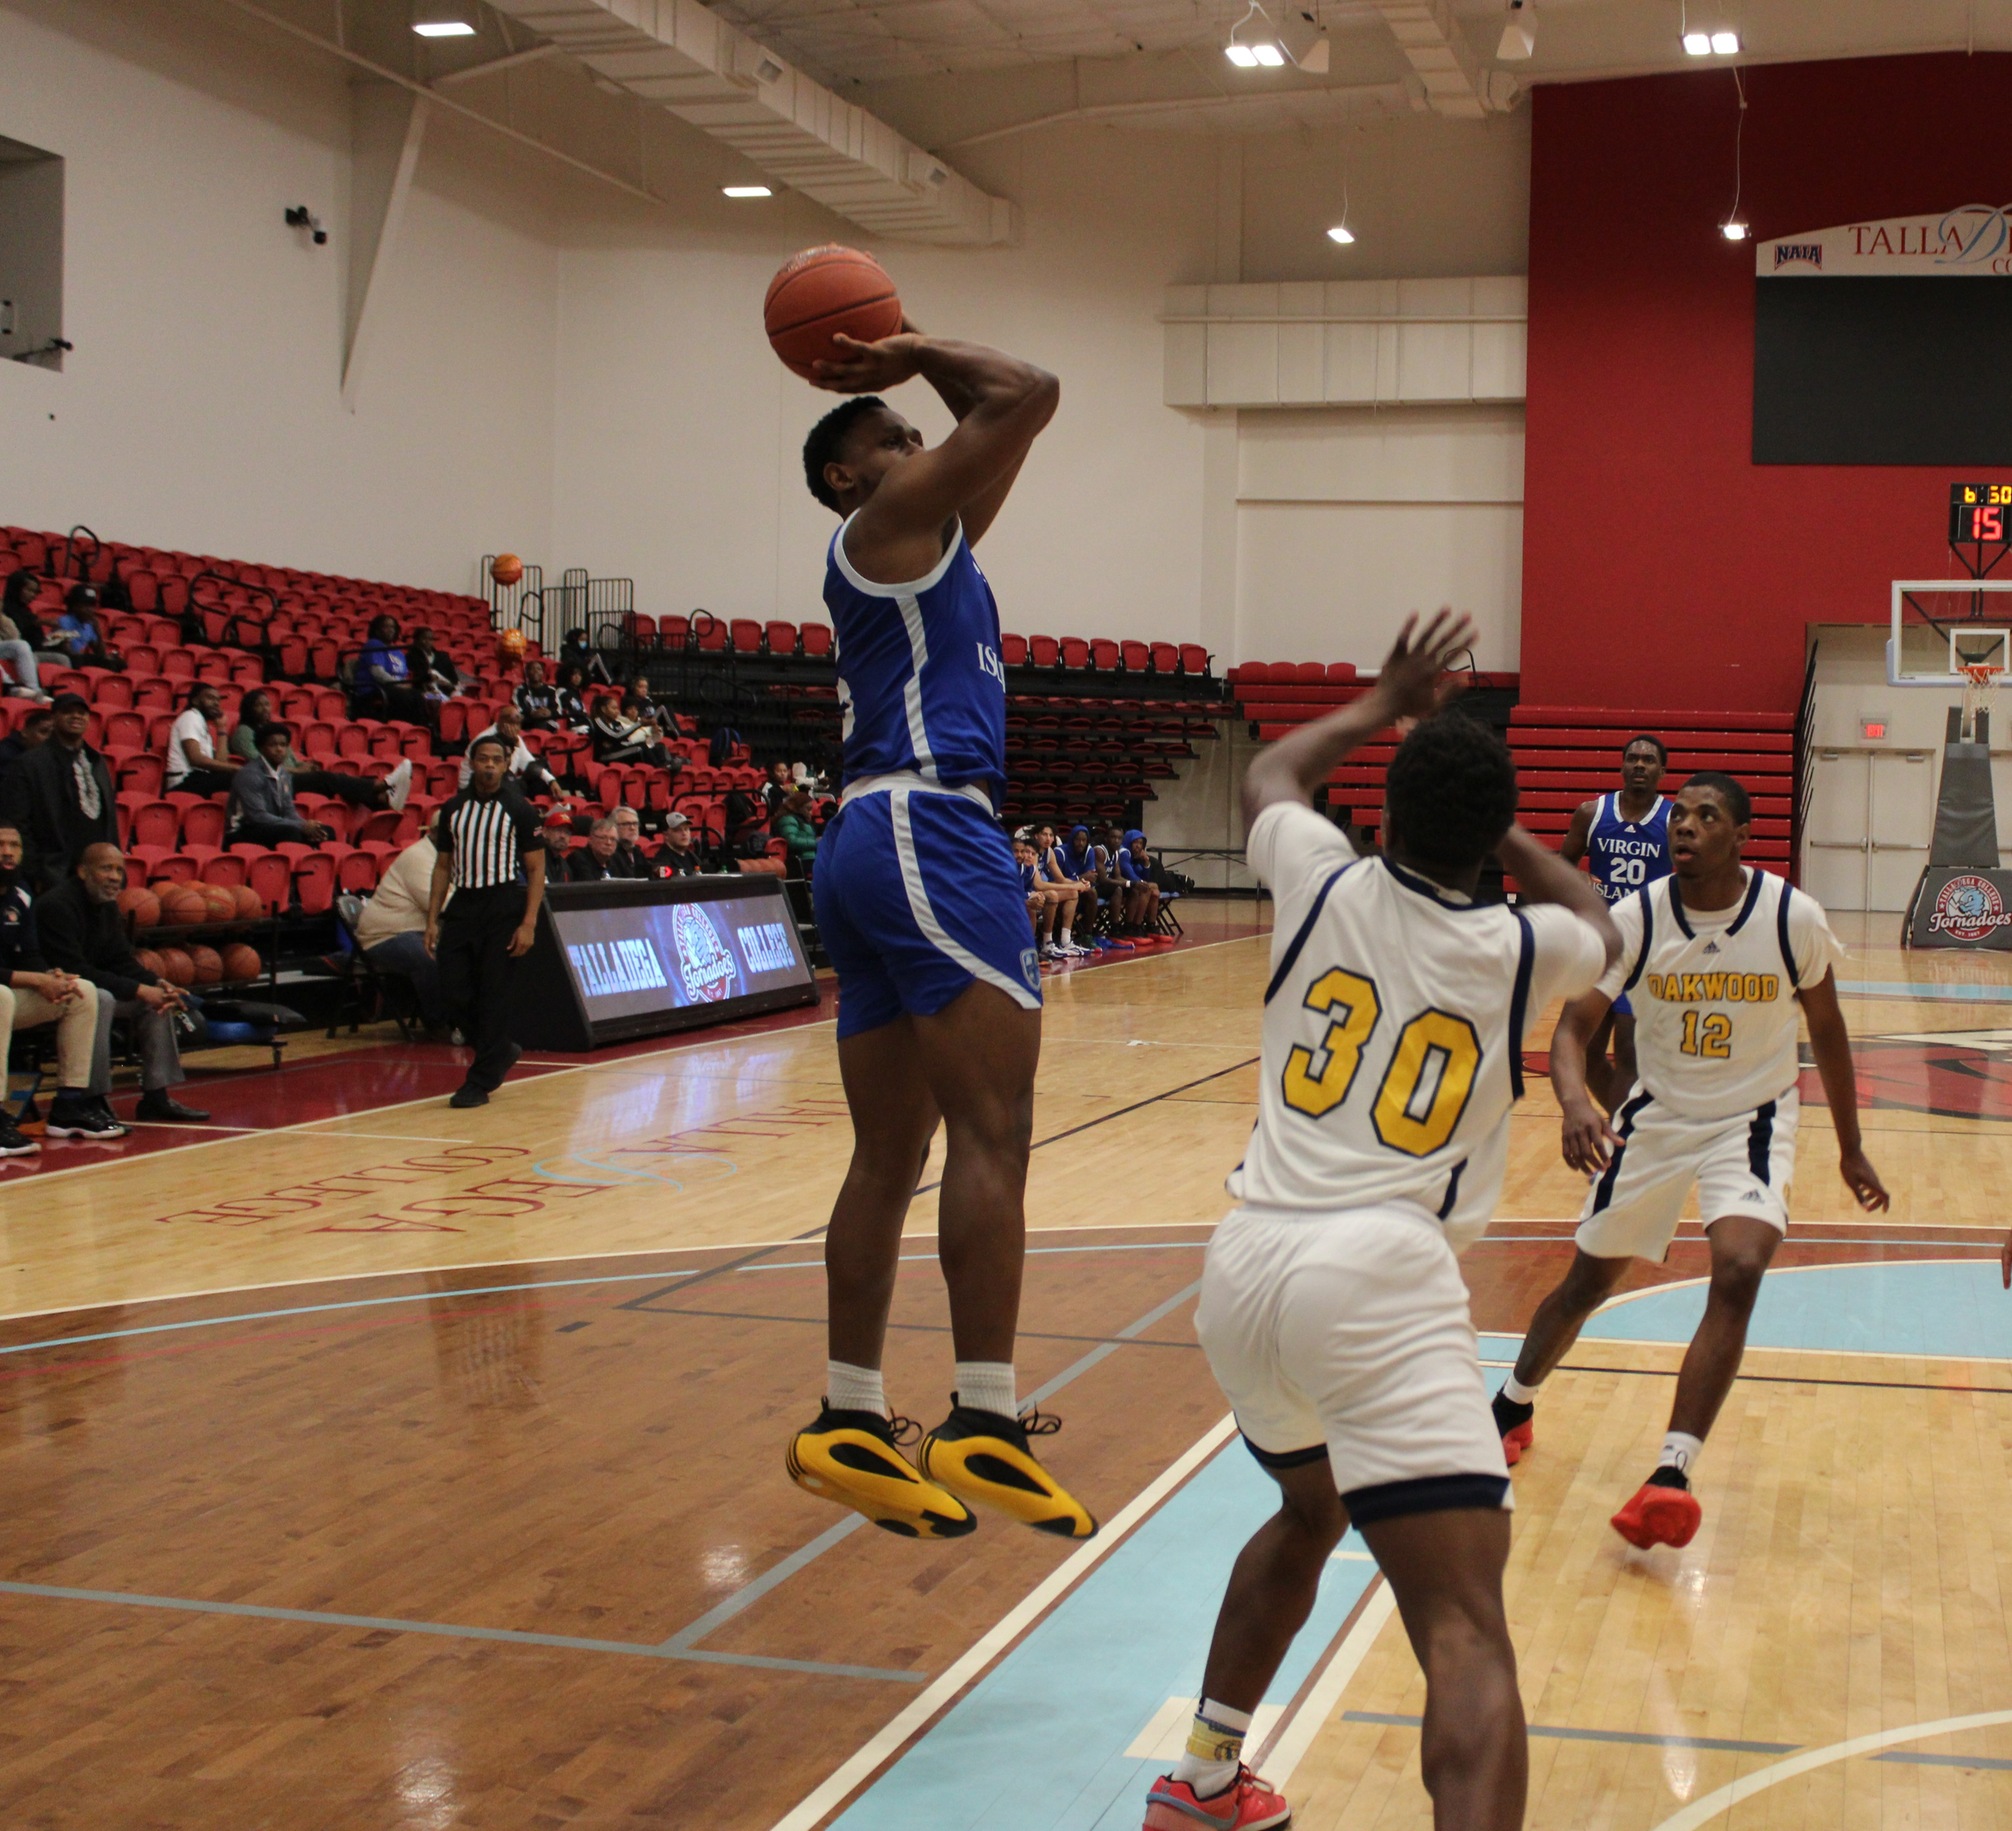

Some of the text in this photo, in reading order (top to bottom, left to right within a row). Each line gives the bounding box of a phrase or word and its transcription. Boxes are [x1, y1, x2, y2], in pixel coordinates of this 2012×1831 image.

[1774, 243, 1823, 271] NAIA
[1972, 506, 2003, 541] 15
[1596, 836, 1662, 859] VIRGIN
[1609, 856, 1647, 886] 20
[1927, 909, 2012, 934] Tornadoes
[567, 938, 668, 998] TALLADEGA
[737, 922, 797, 975] COLLEGE
[681, 951, 736, 1002] Tornadoes
[1647, 971, 1780, 1004] OAKWOOD
[1680, 1009, 1733, 1059] 12
[1280, 965, 1484, 1160] 30
[154, 1144, 534, 1228] COLLEGE
